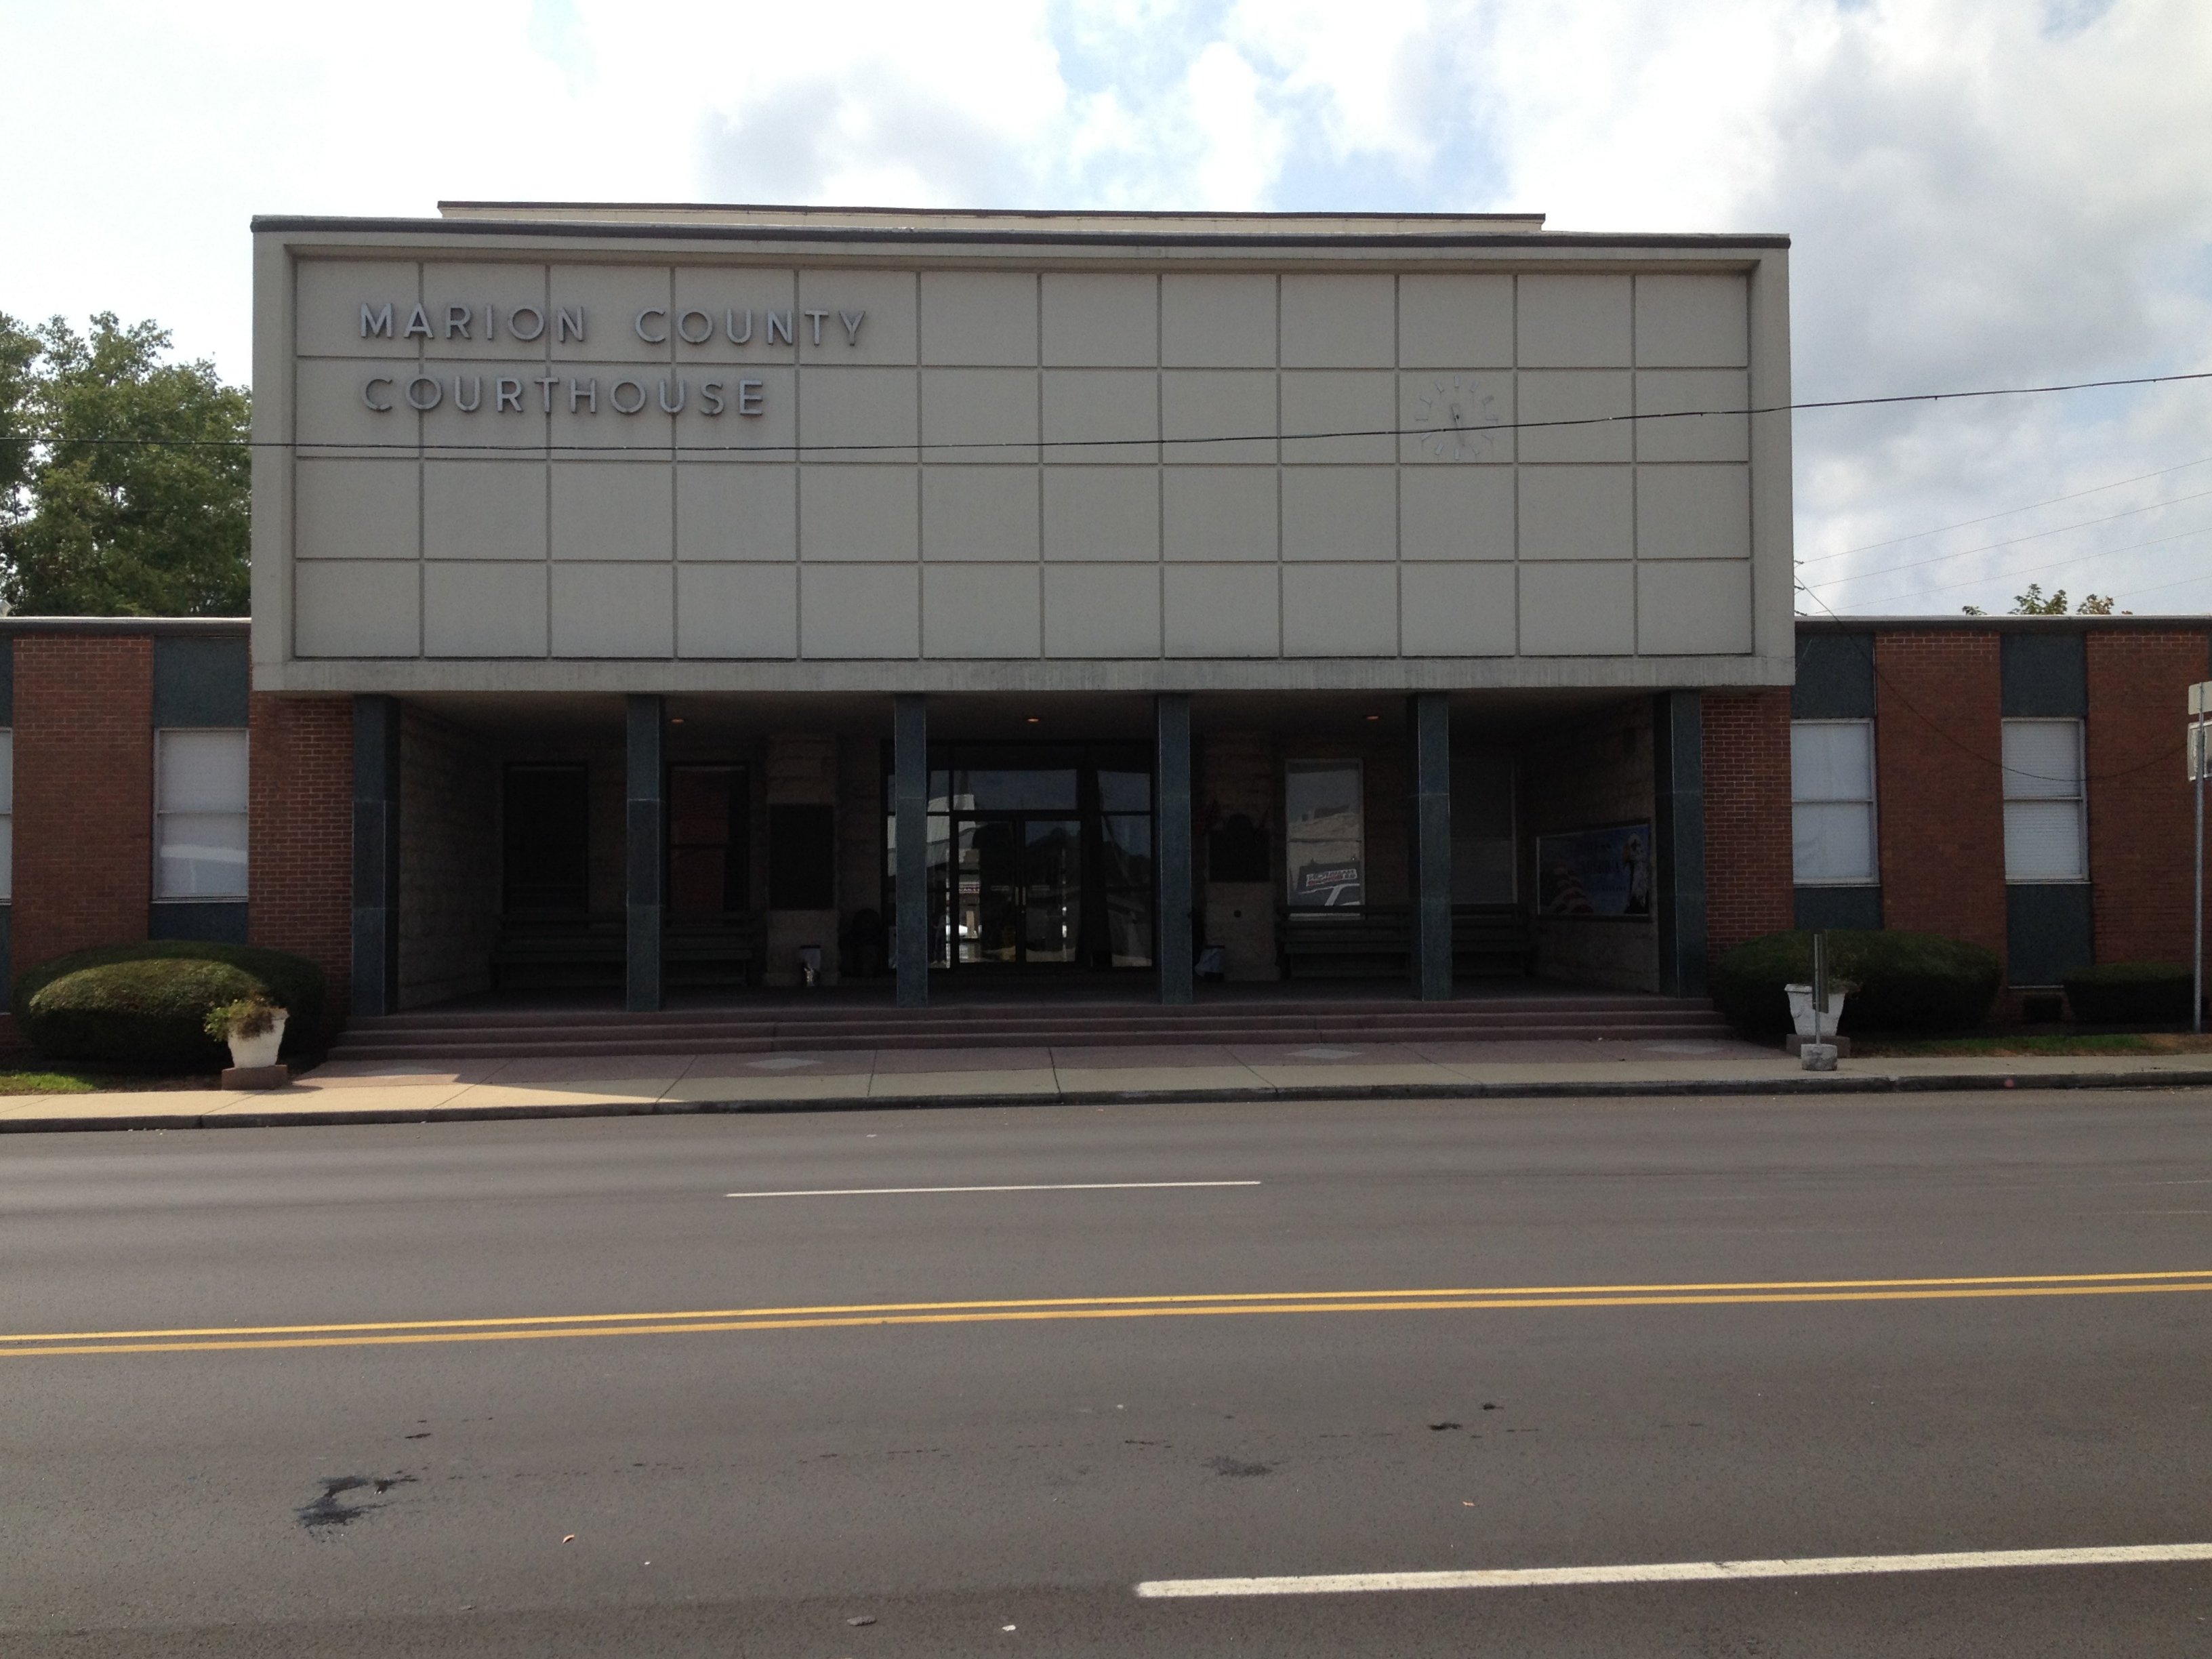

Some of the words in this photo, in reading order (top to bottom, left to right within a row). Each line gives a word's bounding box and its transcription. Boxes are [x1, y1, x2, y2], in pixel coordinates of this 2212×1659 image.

[360, 302, 586, 342] MARION
[635, 308, 866, 346] COUNTY
[363, 376, 763, 415] COURTHOUSE
